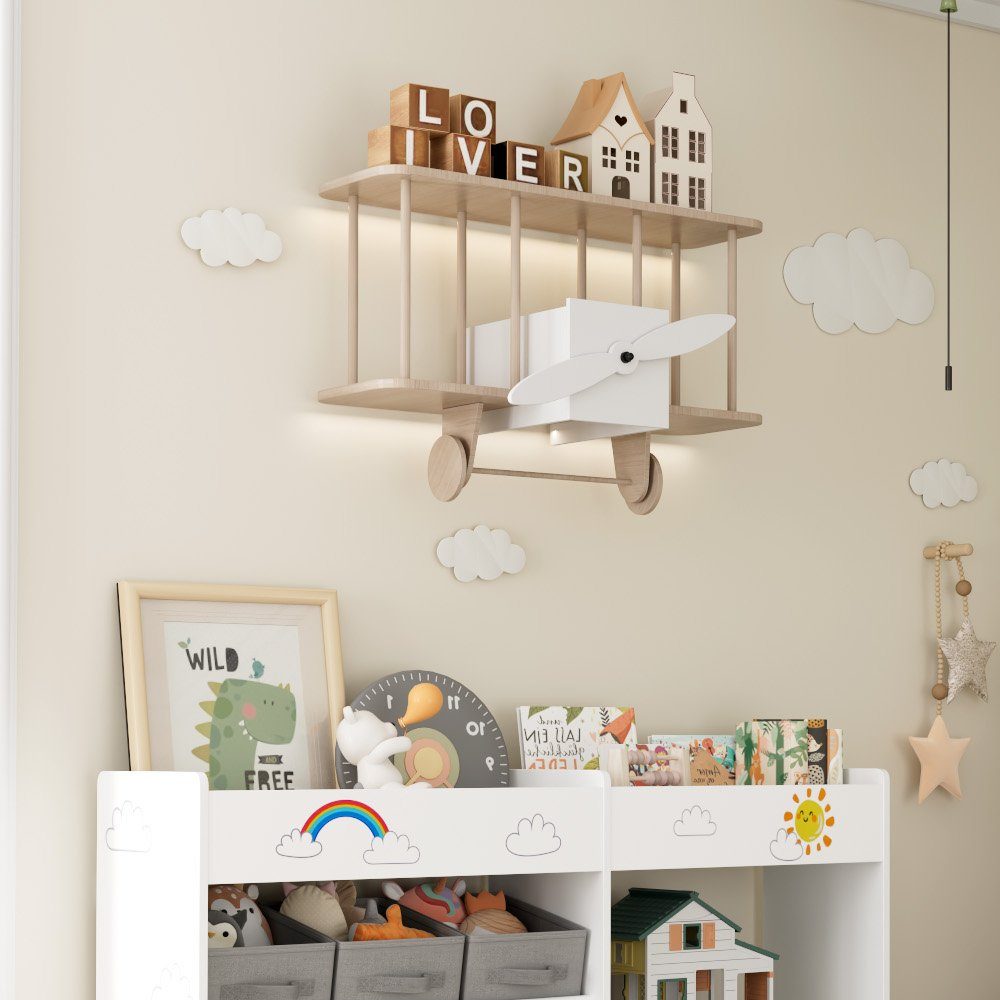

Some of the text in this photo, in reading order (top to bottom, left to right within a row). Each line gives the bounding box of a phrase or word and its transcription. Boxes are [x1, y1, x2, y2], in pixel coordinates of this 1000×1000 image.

[185, 646, 239, 673] WILD
[265, 755, 278, 764] AND
[244, 770, 295, 790] FREE
